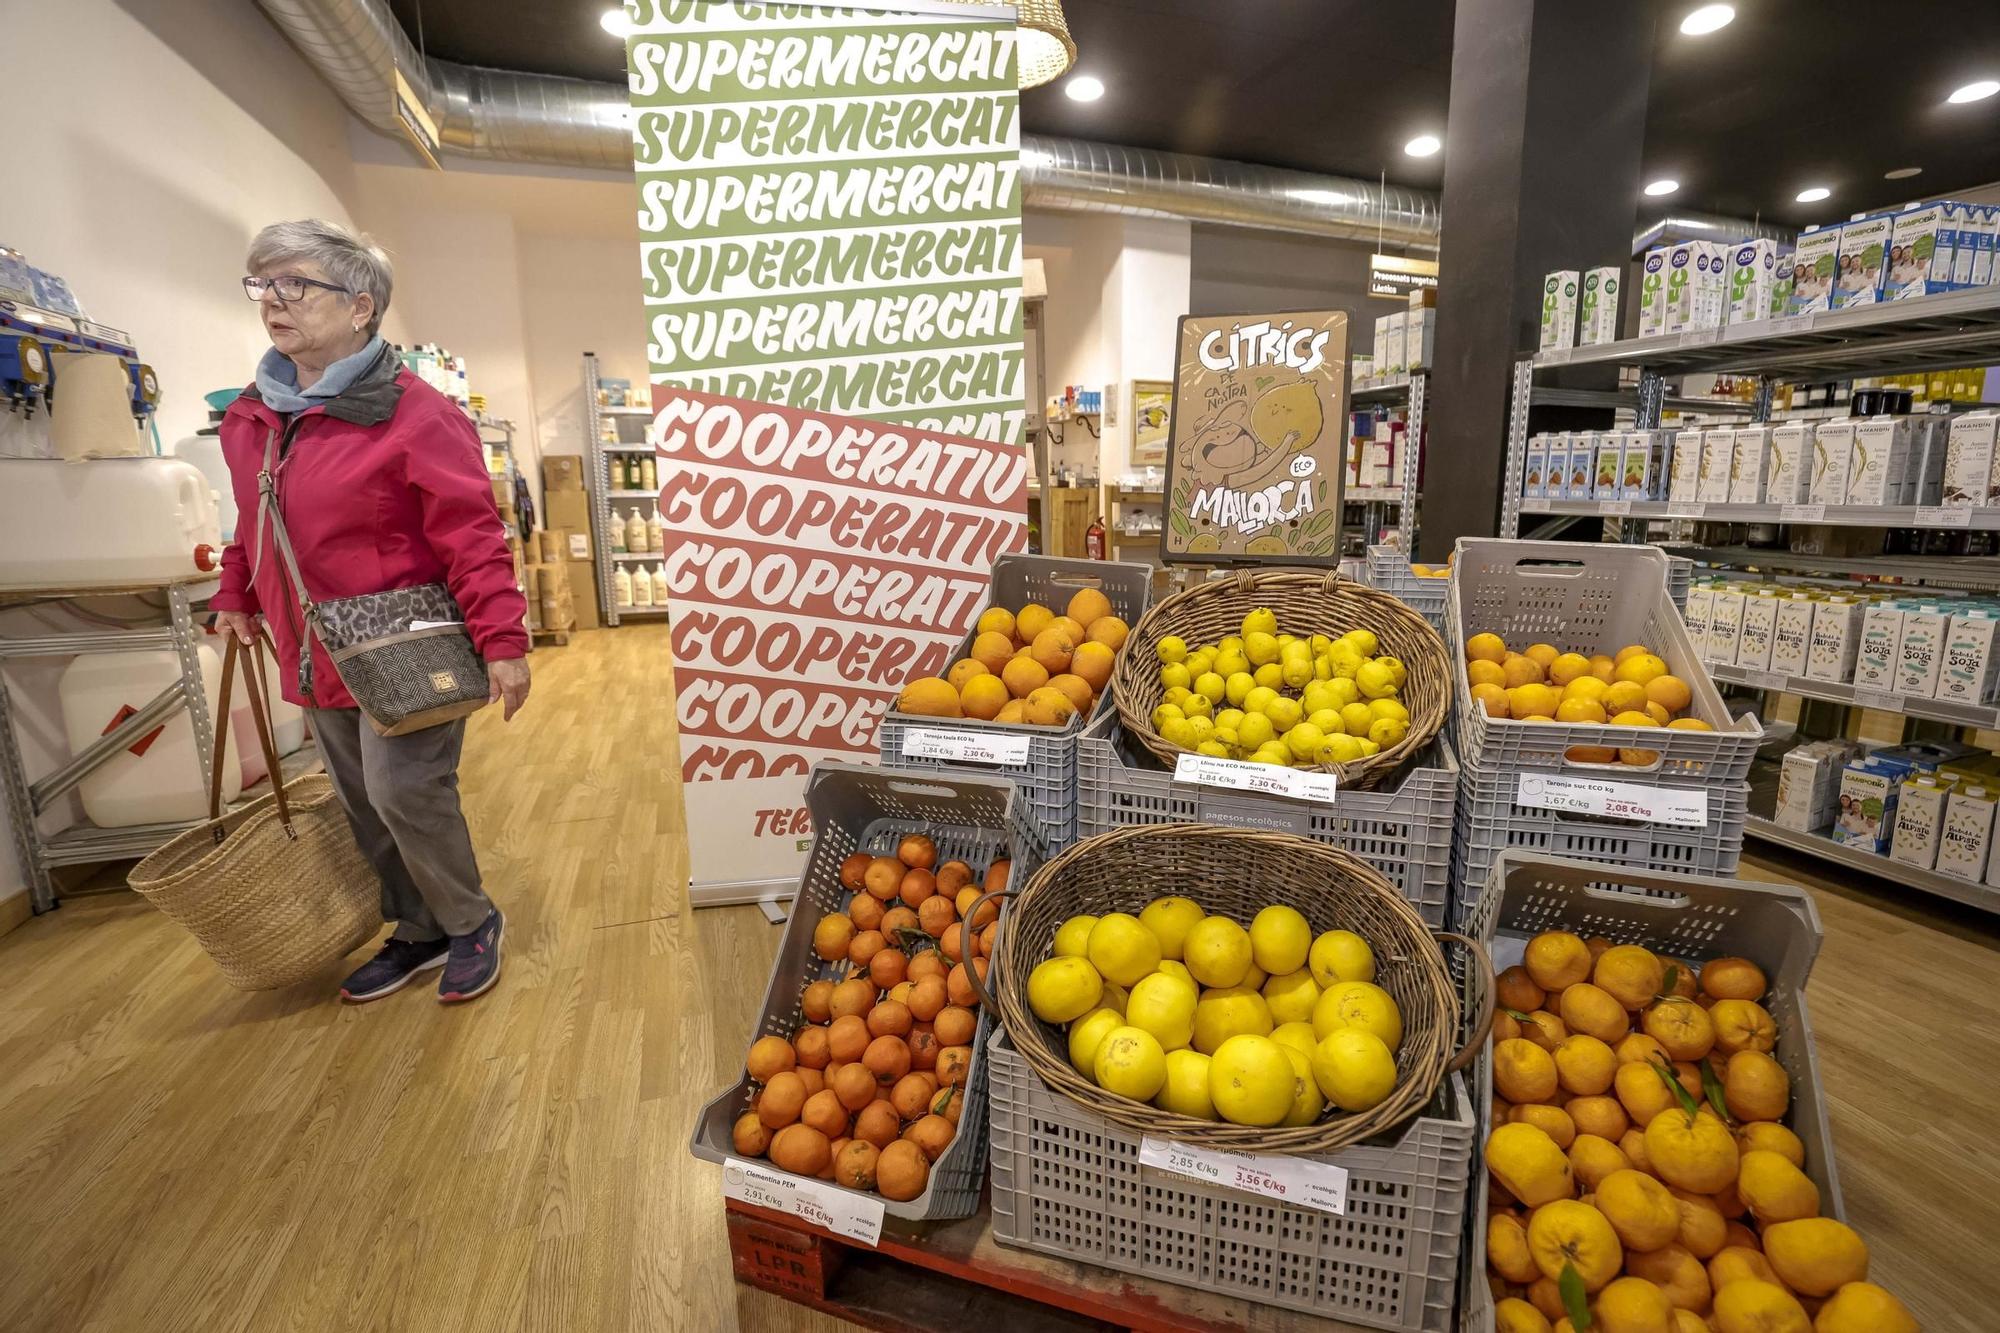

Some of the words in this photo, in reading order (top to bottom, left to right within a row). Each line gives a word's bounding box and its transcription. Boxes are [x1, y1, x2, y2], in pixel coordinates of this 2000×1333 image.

[629, 30, 1018, 97] SUPERMERCAT
[635, 95, 1020, 164] SUPERMERCAT
[638, 160, 1020, 232] SUPERMERCAT
[644, 224, 1021, 298] SUPERMERCAT
[648, 286, 1022, 365] SUPERMERCAT
[1208, 383, 1248, 412] NOSTRA
[654, 396, 1026, 504] COOPERATIU
[1294, 460, 1313, 473] ECO
[1190, 480, 1314, 535] MALLORCA
[671, 610, 959, 686] COOPERA
[963, 749, 979, 758] 2,30
[980, 750, 995, 759] €/kg
[1199, 773, 1217, 782] 1,84
[1218, 775, 1236, 785] €/kg
[1250, 779, 1269, 788] 2,30
[1270, 782, 1289, 793] €/kg
[1573, 782, 1587, 790] suc
[1588, 783, 1603, 792] ECO
[1604, 784, 1614, 793] kg
[1544, 795, 1565, 805] 1,67
[1568, 798, 1590, 809] €/kg
[1605, 802, 1628, 813] 2,08
[1630, 805, 1652, 817] €/kg
[754, 808, 815, 838] TER
[1205, 811, 1244, 824] pagesos
[1169, 1155, 1193, 1169] 2,85
[1196, 1161, 1219, 1177] €/kg
[745, 1169, 781, 1186] Clementina
[1235, 1171, 1260, 1186] 3,56
[1263, 1179, 1286, 1194] €/kg
[744, 1188, 763, 1201] 2,91
[765, 1192, 782, 1207] €/kg
[1310, 1197, 1338, 1209] Mallorca
[795, 1203, 815, 1217] 3,64
[816, 1210, 834, 1225] €/kg
